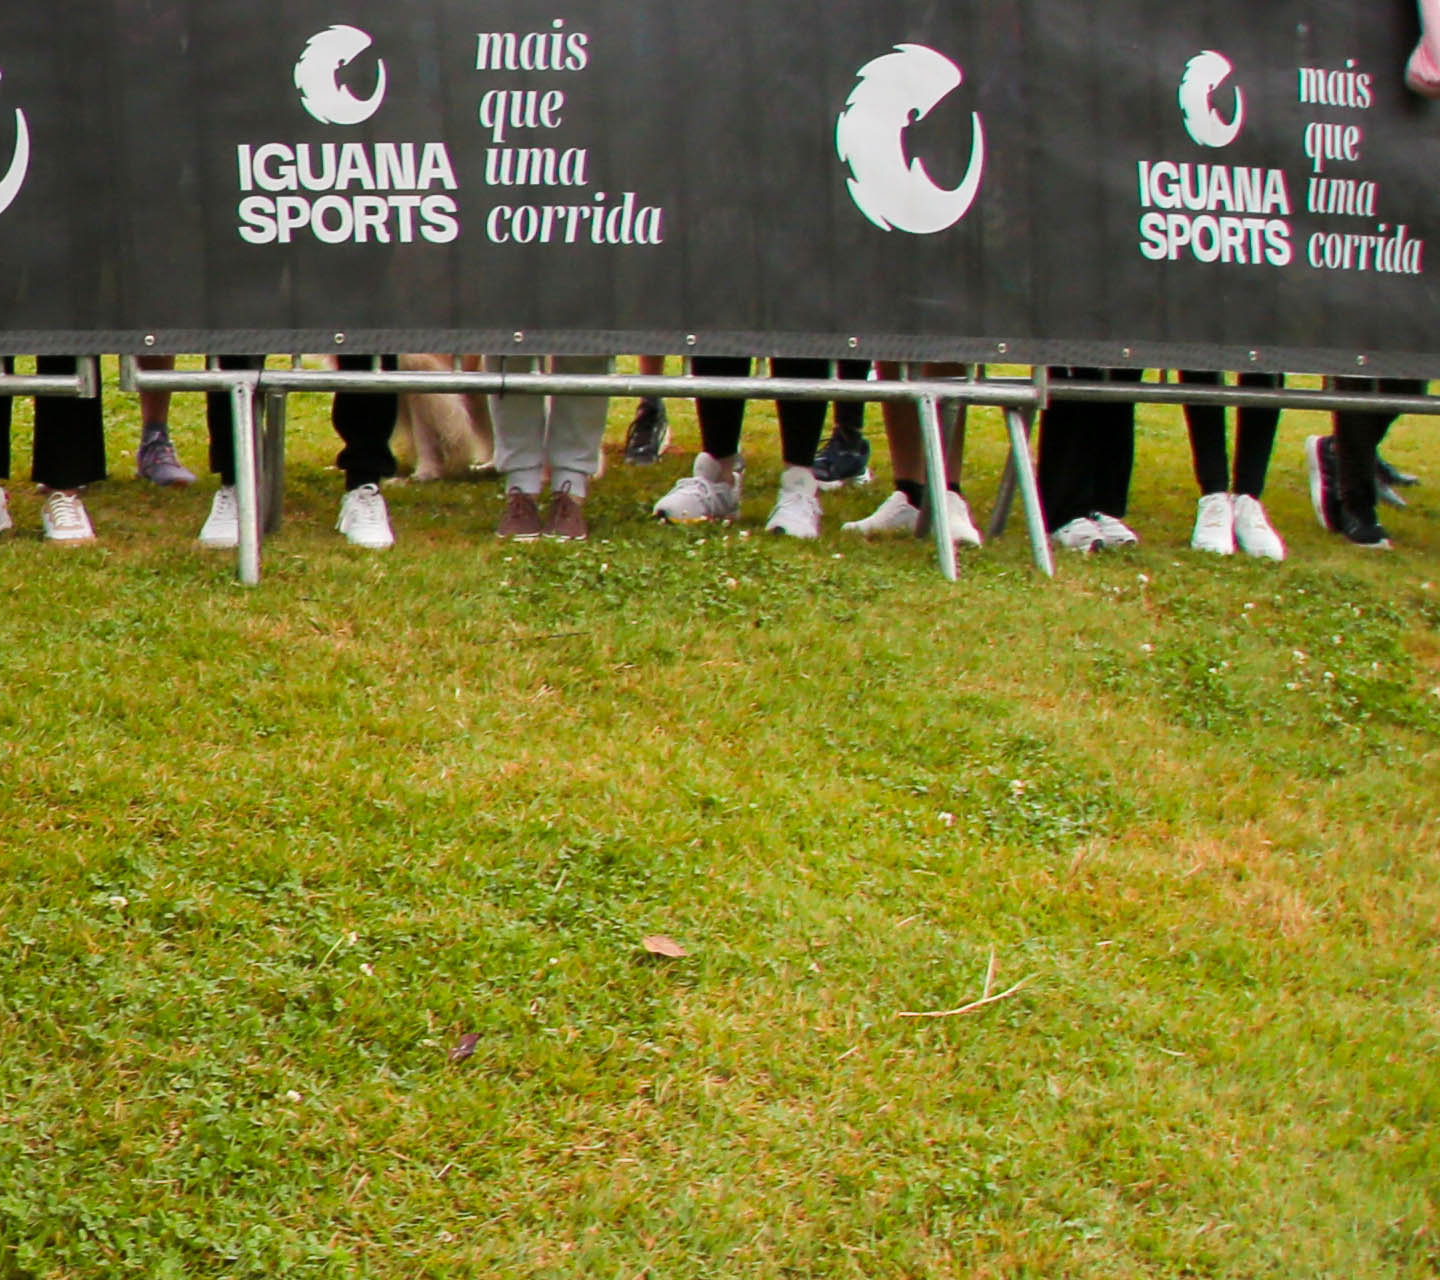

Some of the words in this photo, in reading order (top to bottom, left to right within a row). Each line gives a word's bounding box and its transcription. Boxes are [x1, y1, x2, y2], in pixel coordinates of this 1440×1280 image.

[475, 18, 589, 72] mais
[1299, 60, 1372, 108] mais
[480, 89, 564, 143] que
[237, 143, 457, 192] IGUANA
[484, 147, 587, 187] uma
[1305, 122, 1360, 171] que
[1138, 161, 1290, 216] IGUANA
[1306, 174, 1377, 217] uma
[237, 195, 459, 244] SPORTS
[485, 193, 663, 246] corrida
[1139, 213, 1292, 267] SPORTS
[1307, 223, 1423, 275] corrida
